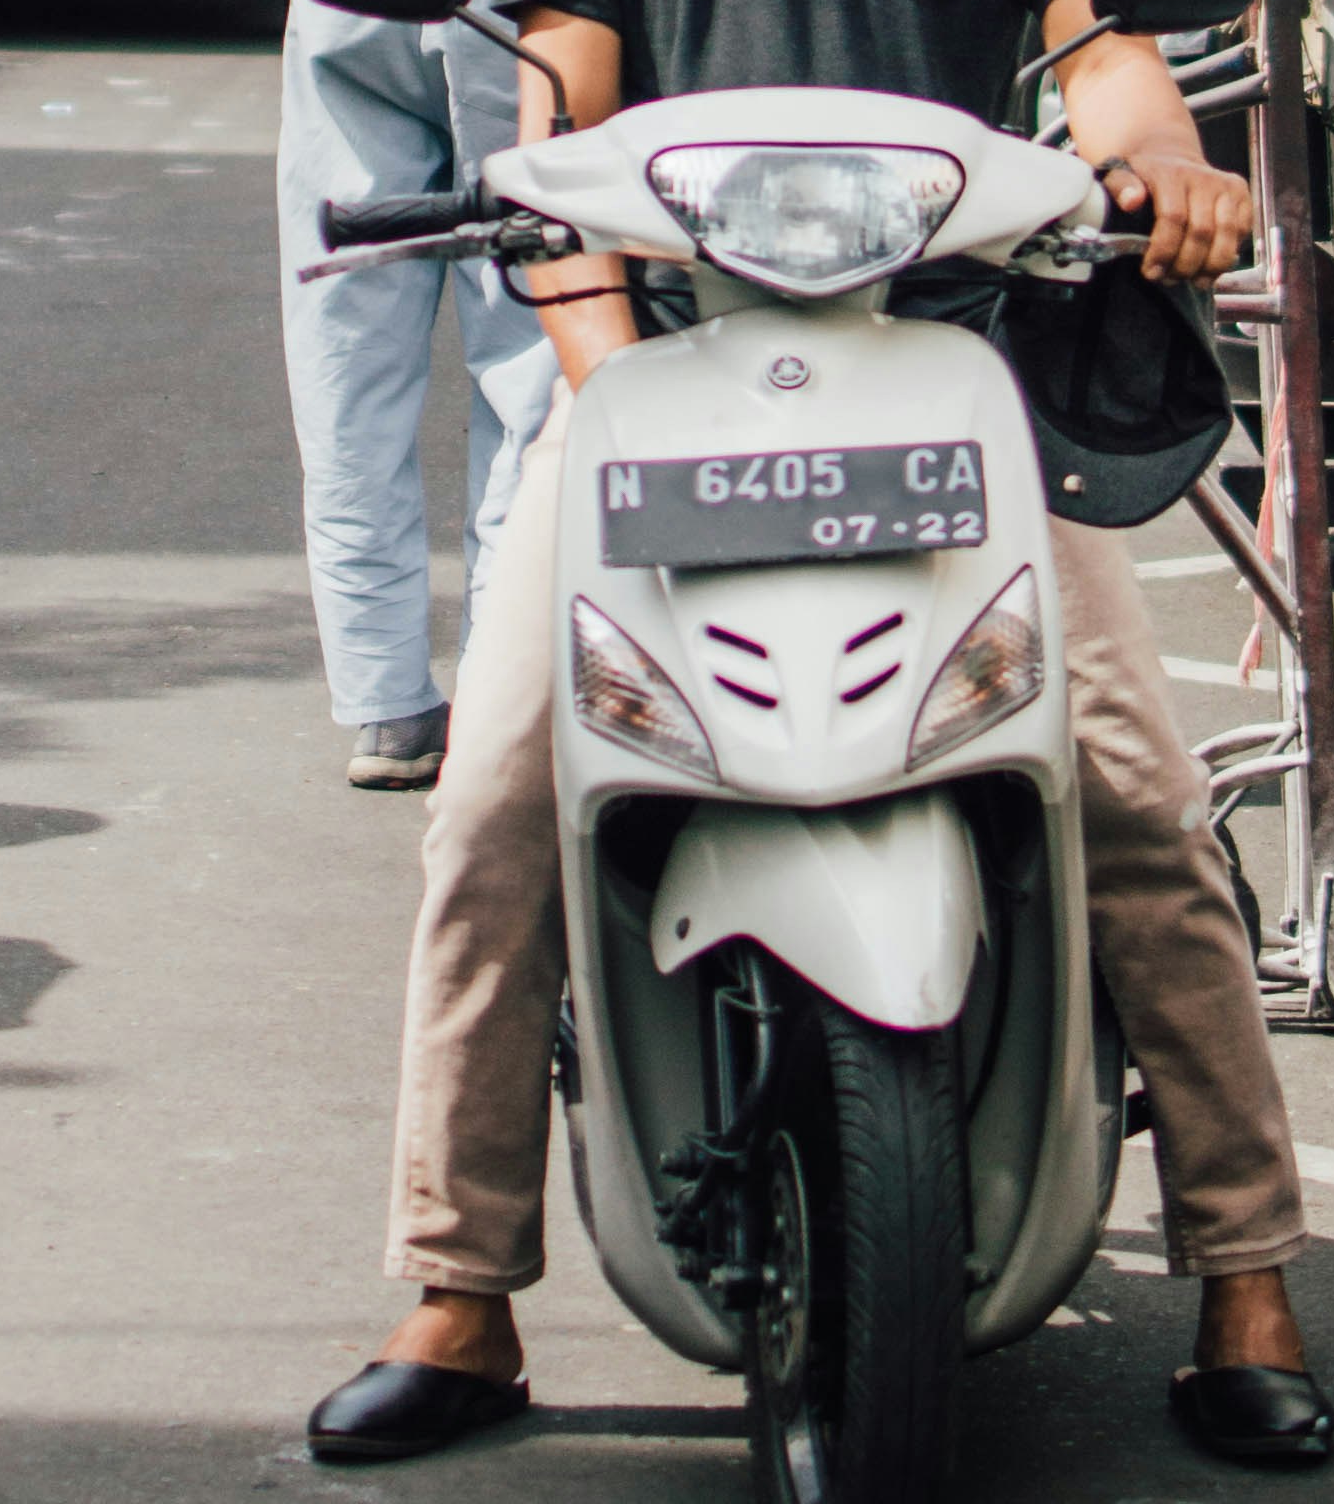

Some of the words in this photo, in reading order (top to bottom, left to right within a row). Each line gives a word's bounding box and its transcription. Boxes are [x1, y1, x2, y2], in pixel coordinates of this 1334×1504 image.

[606, 463, 644, 510] N
[695, 452, 846, 503] 6405
[905, 445, 981, 492] CA
